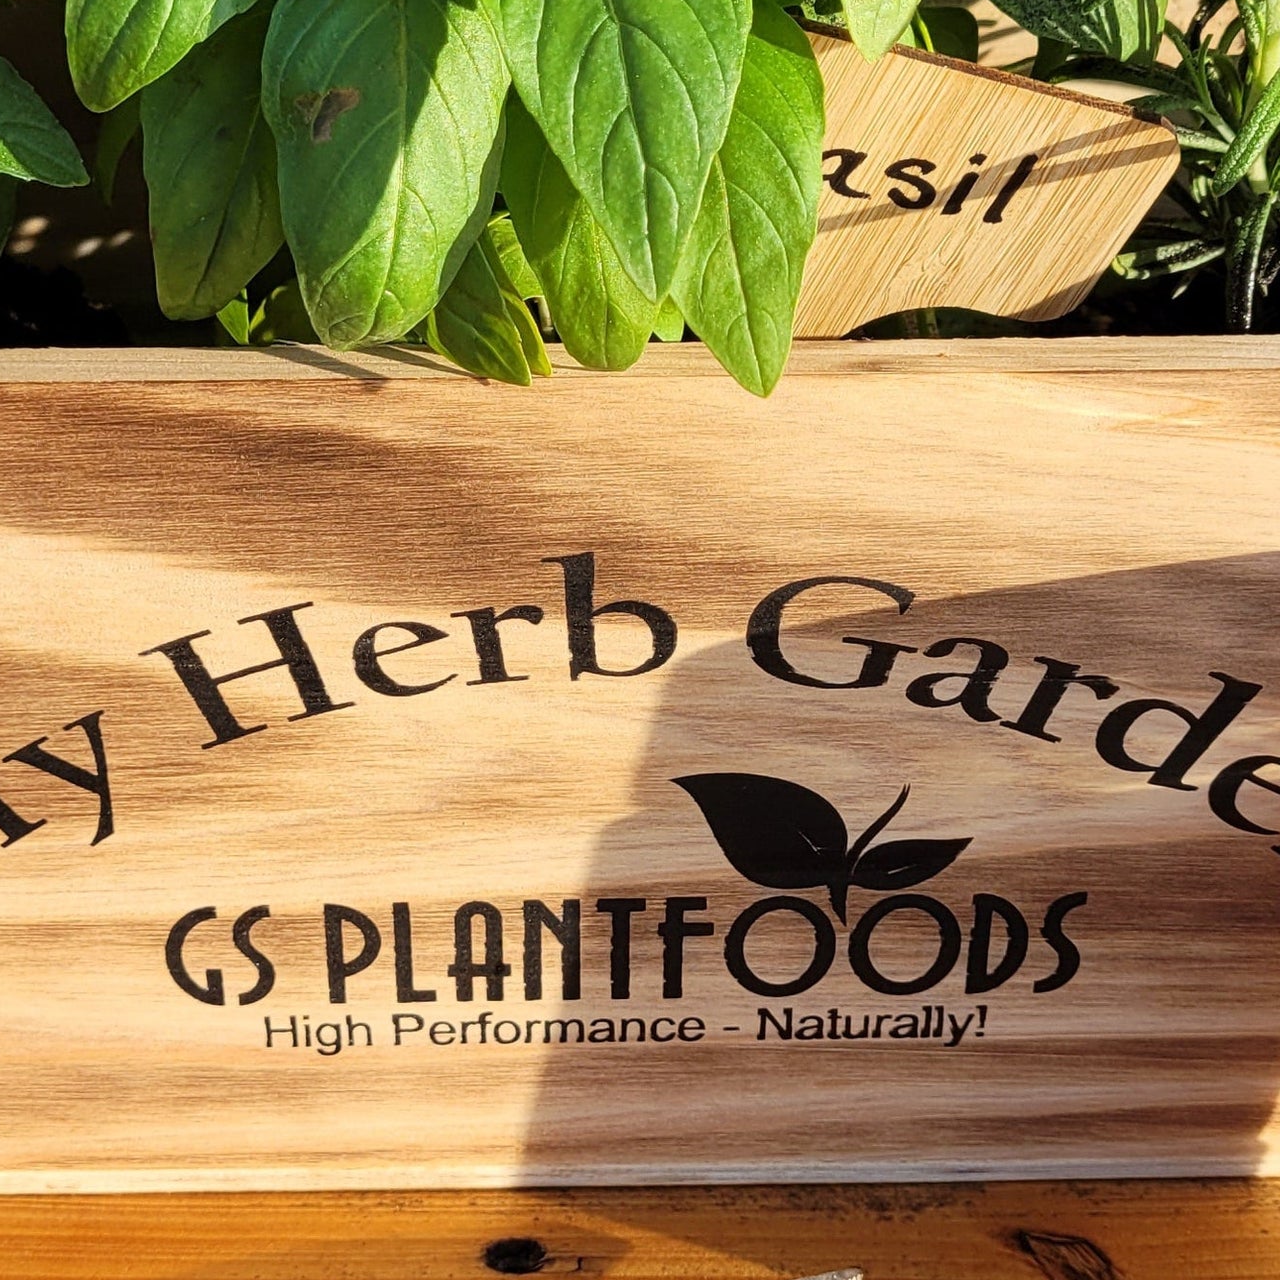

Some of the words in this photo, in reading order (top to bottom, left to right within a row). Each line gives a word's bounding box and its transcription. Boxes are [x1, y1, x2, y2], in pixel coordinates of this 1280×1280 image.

[822, 148, 1039, 225] asil
[139, 551, 678, 750] Herb
[165, 905, 276, 1007] GS
[324, 891, 1089, 1005] PLANTFOODS
[264, 1015, 374, 1057] High
[393, 1011, 706, 1046] Performance
[756, 1004, 988, 1048] Naturally!
